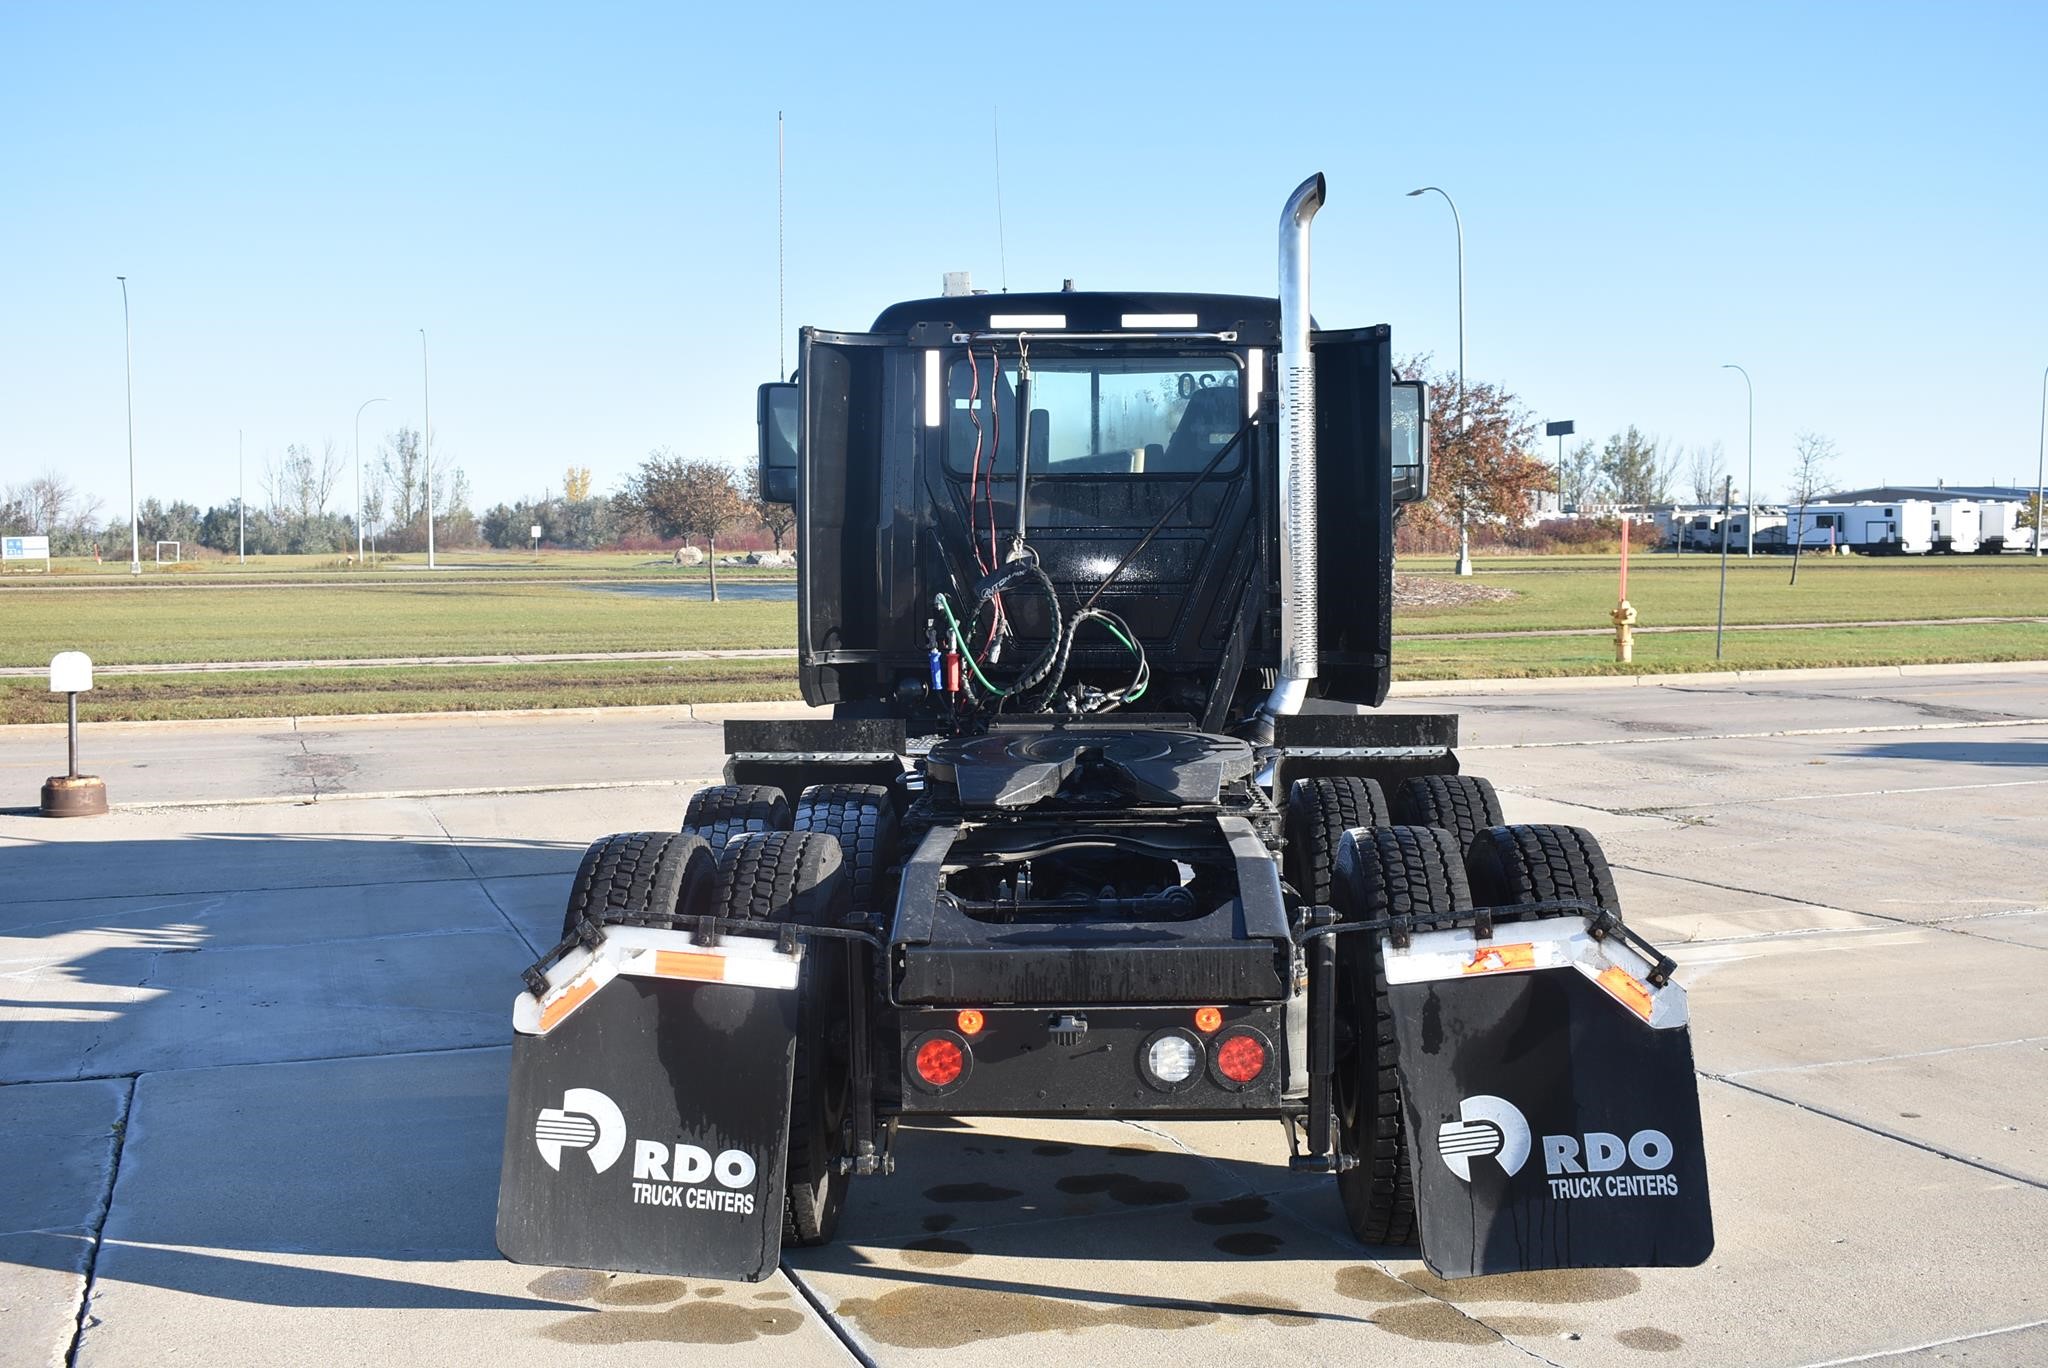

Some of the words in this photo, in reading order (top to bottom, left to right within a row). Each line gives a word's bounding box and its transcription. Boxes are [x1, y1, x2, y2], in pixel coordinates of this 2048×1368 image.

[633, 1139, 756, 1188] RDO
[1542, 1129, 1674, 1175] RDO
[632, 1183, 683, 1208] TRUCK
[686, 1187, 755, 1215] CENTERS
[1548, 1176, 1602, 1199] TRUCK
[1605, 1174, 1679, 1197] CENTERS
